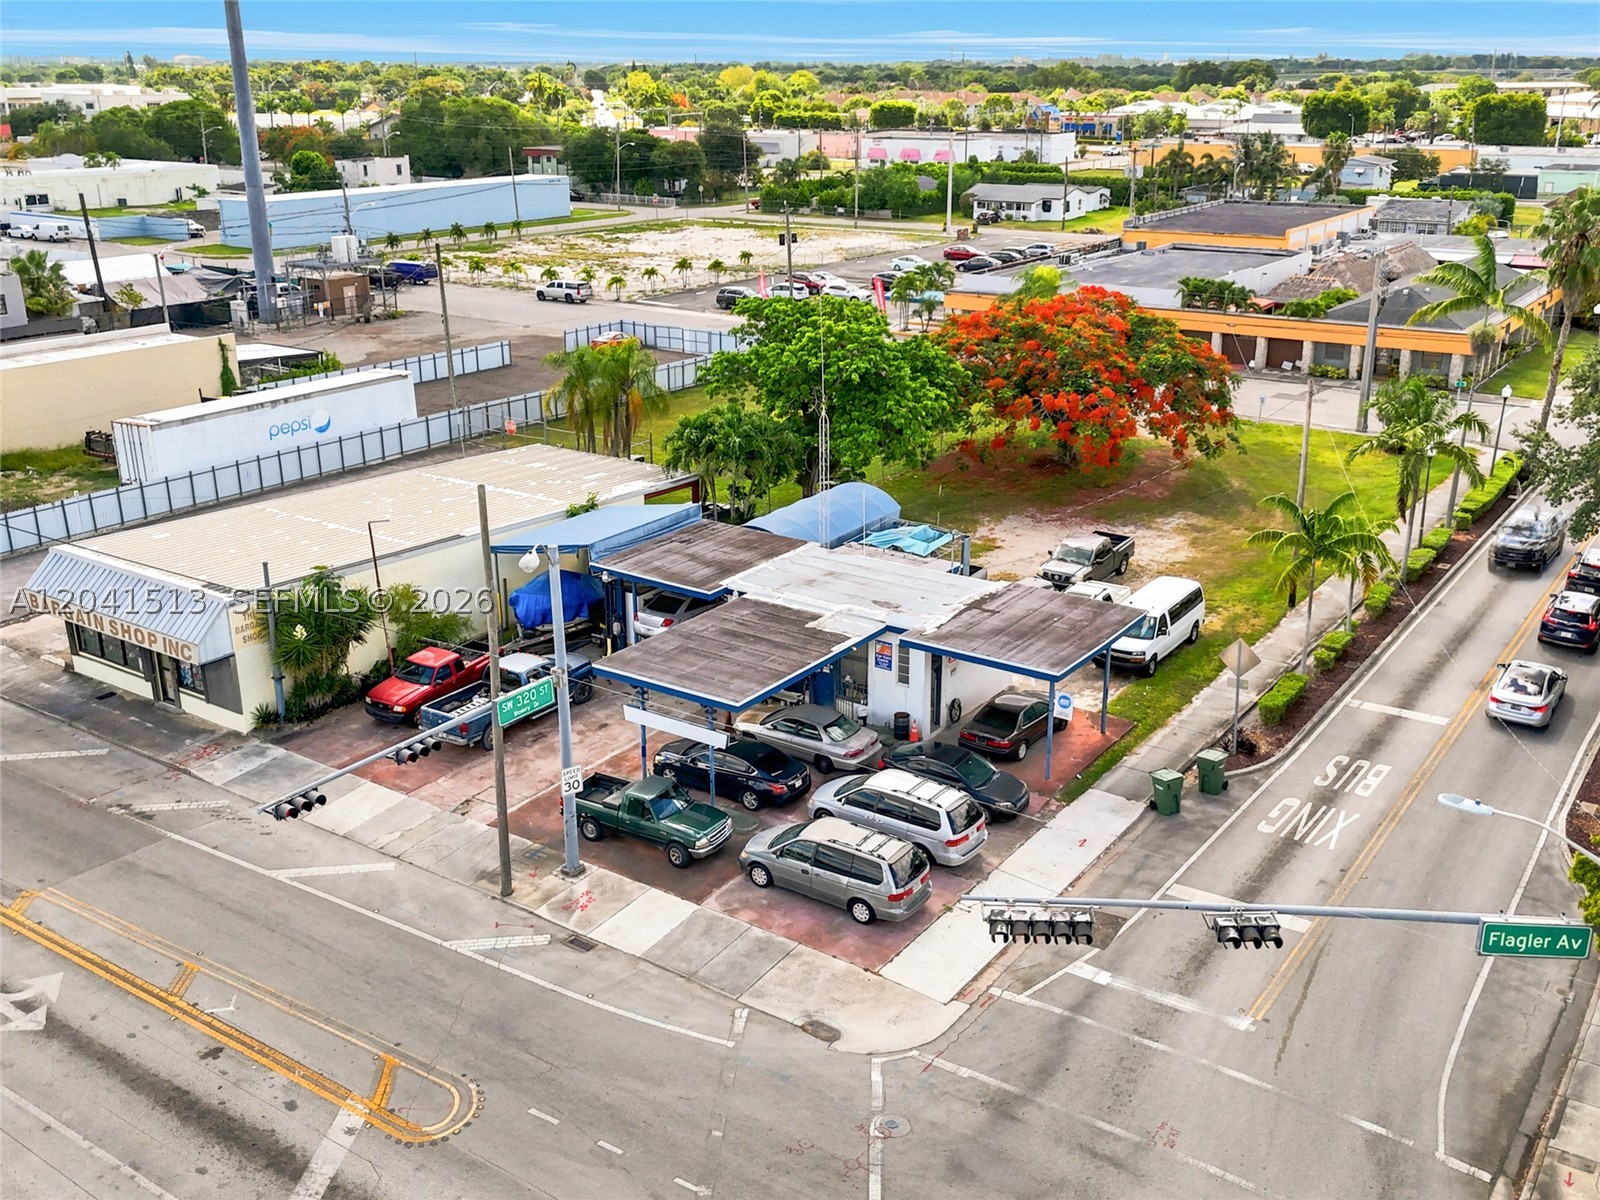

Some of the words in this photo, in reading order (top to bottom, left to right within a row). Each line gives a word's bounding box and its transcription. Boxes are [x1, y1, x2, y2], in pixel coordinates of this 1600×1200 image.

[269, 415, 311, 441] pepsi
[109, 620, 157, 648] SHOP
[162, 637, 193, 661] INC
[501, 700, 514, 713] SW
[516, 688, 537, 707] 320
[539, 683, 549, 696] ST
[562, 767, 581, 777] SPEED
[564, 779, 581, 793] 30
[1312, 755, 1392, 797] BUS
[1257, 797, 1360, 850] XING
[1488, 931, 1552, 952] Flagler
[1555, 934, 1583, 950] Av
